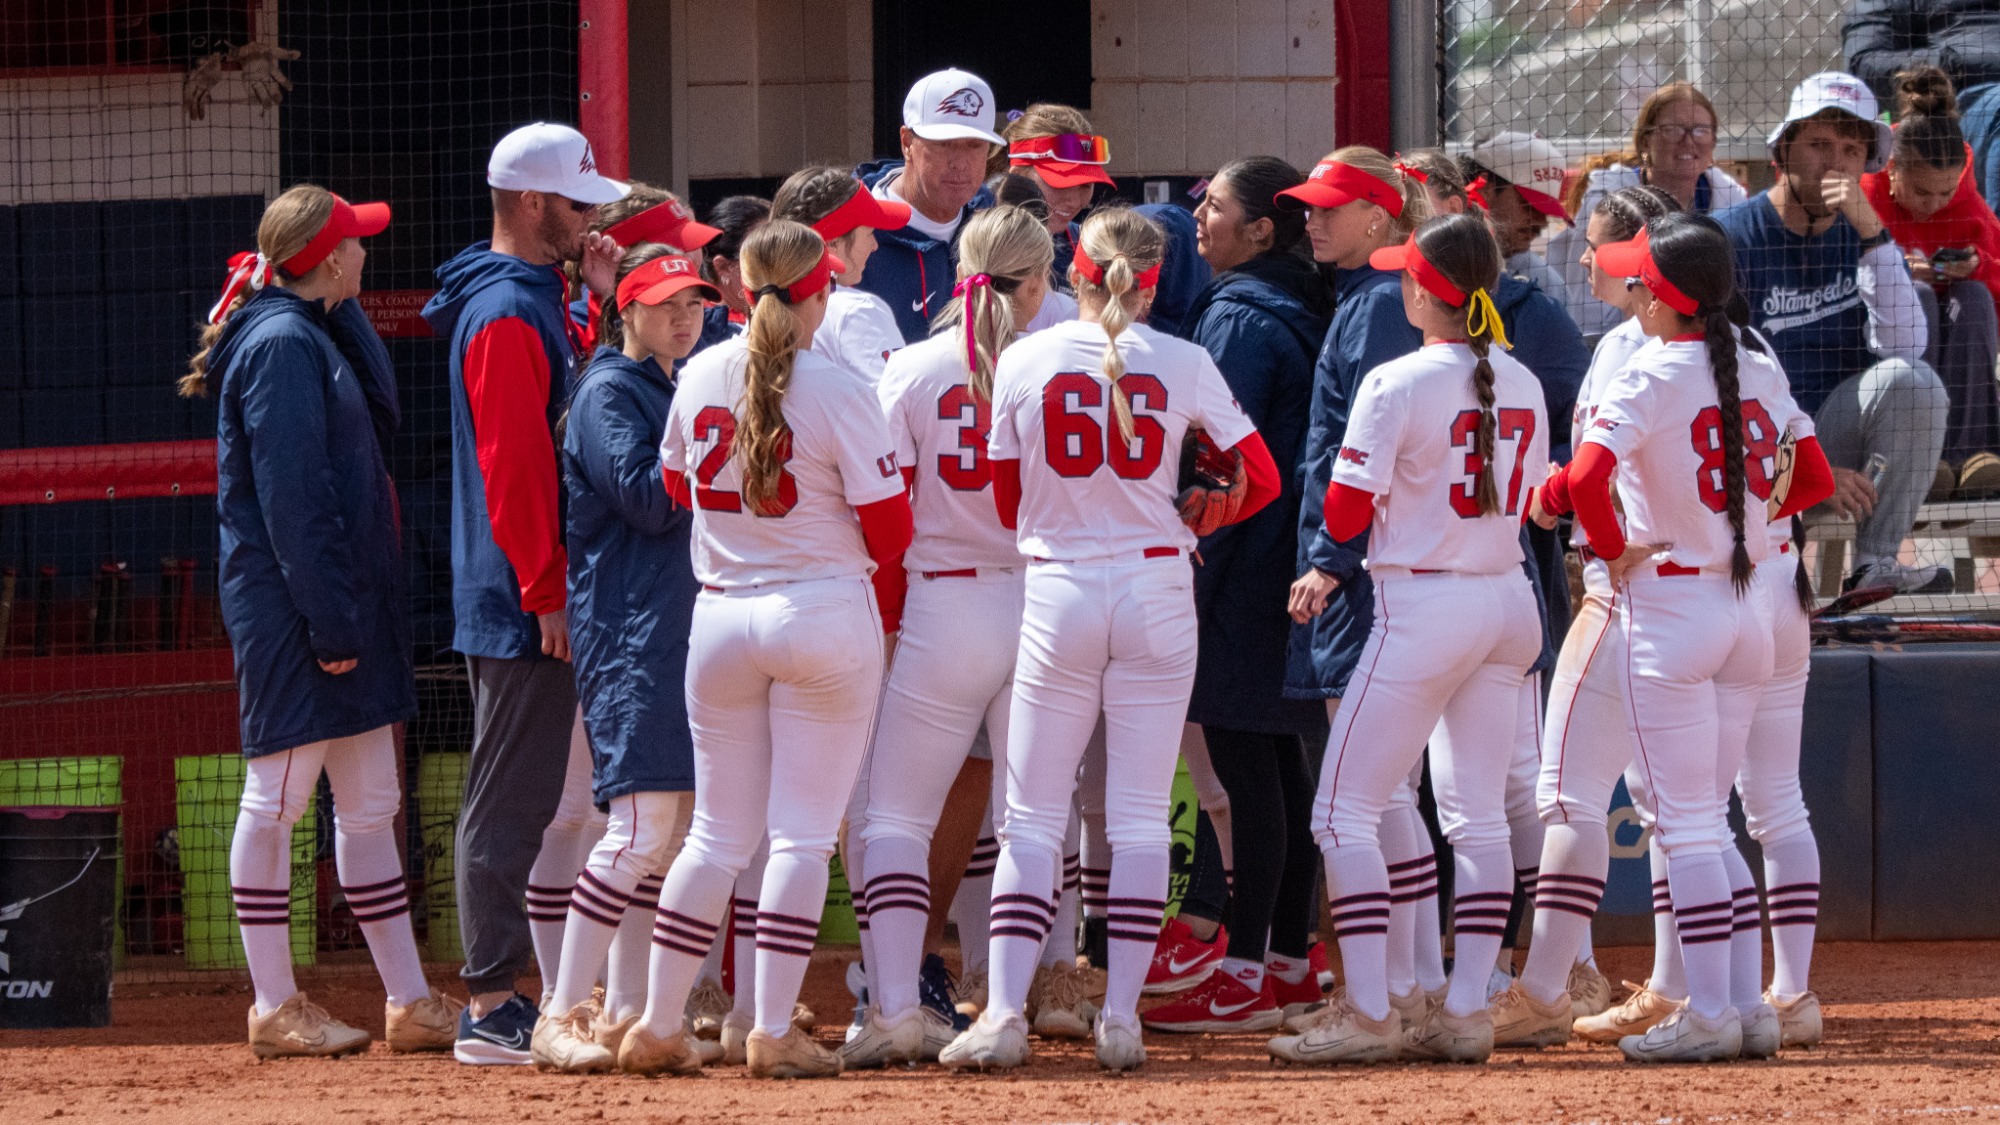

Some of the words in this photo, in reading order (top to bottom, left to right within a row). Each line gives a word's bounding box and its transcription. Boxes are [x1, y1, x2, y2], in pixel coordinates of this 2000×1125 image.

[661, 259, 689, 275] UT
[1763, 271, 1859, 316] Stampede
[1042, 371, 1168, 480] 66
[1449, 407, 1536, 519] 37
[1690, 398, 1780, 514] 88
